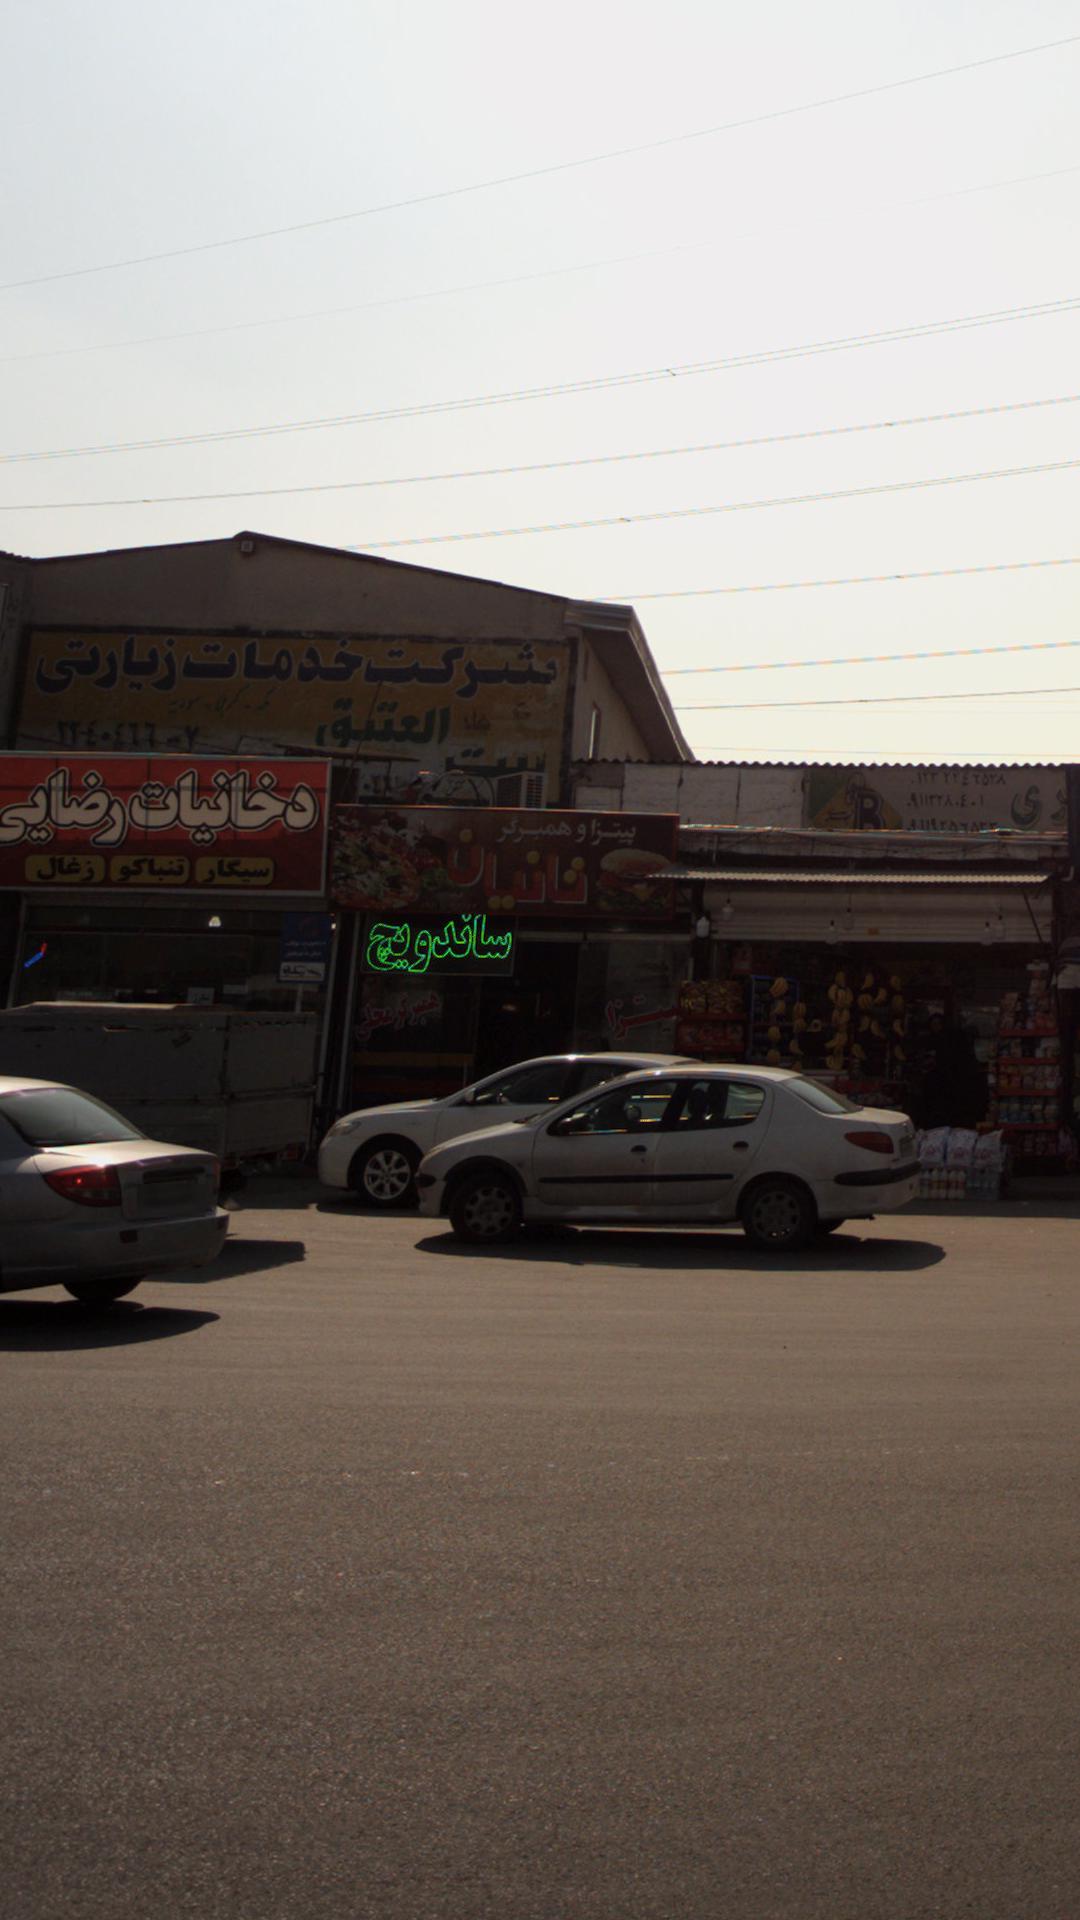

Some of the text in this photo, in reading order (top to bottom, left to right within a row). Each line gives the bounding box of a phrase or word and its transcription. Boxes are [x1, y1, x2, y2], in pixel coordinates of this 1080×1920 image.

[35, 636, 557, 698] شرکت خدمات زیارتی
[0, 766, 319, 848] دخانیات رضایی
[496, 817, 637, 846] پیتزا و همبرگر
[37, 856, 95, 881] زغال
[117, 857, 186, 881] تنباکو
[366, 913, 514, 974] ساندویچ
